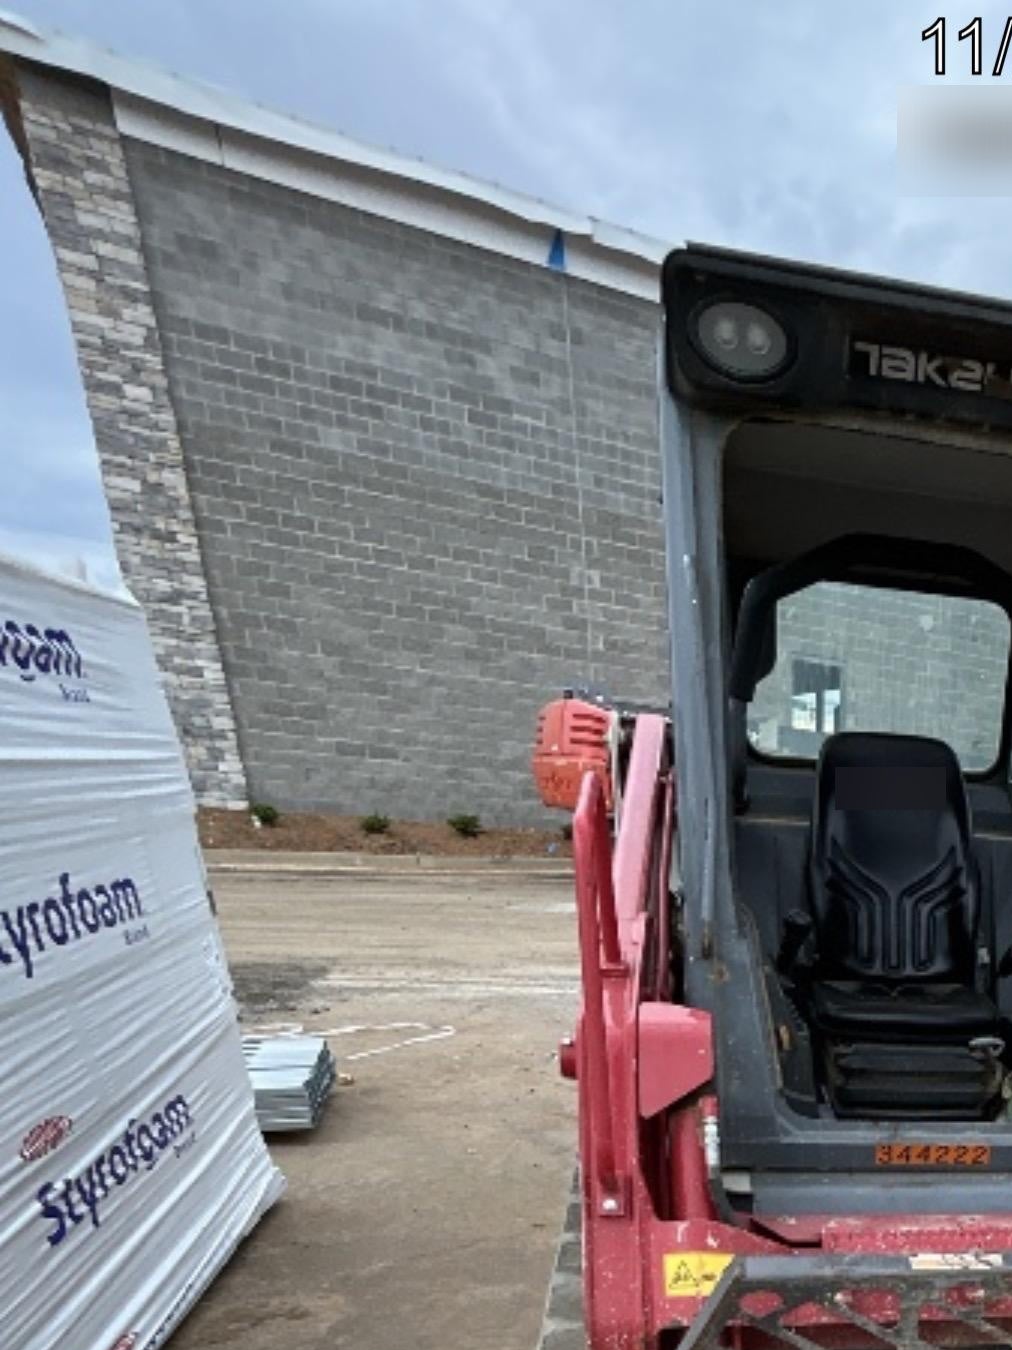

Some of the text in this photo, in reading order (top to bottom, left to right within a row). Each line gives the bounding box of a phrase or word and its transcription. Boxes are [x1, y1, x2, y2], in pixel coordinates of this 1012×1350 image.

[0, 872, 143, 979] yrofoam
[36, 1094, 192, 1247] Styrofoam
[879, 1145, 989, 1165] 344222
